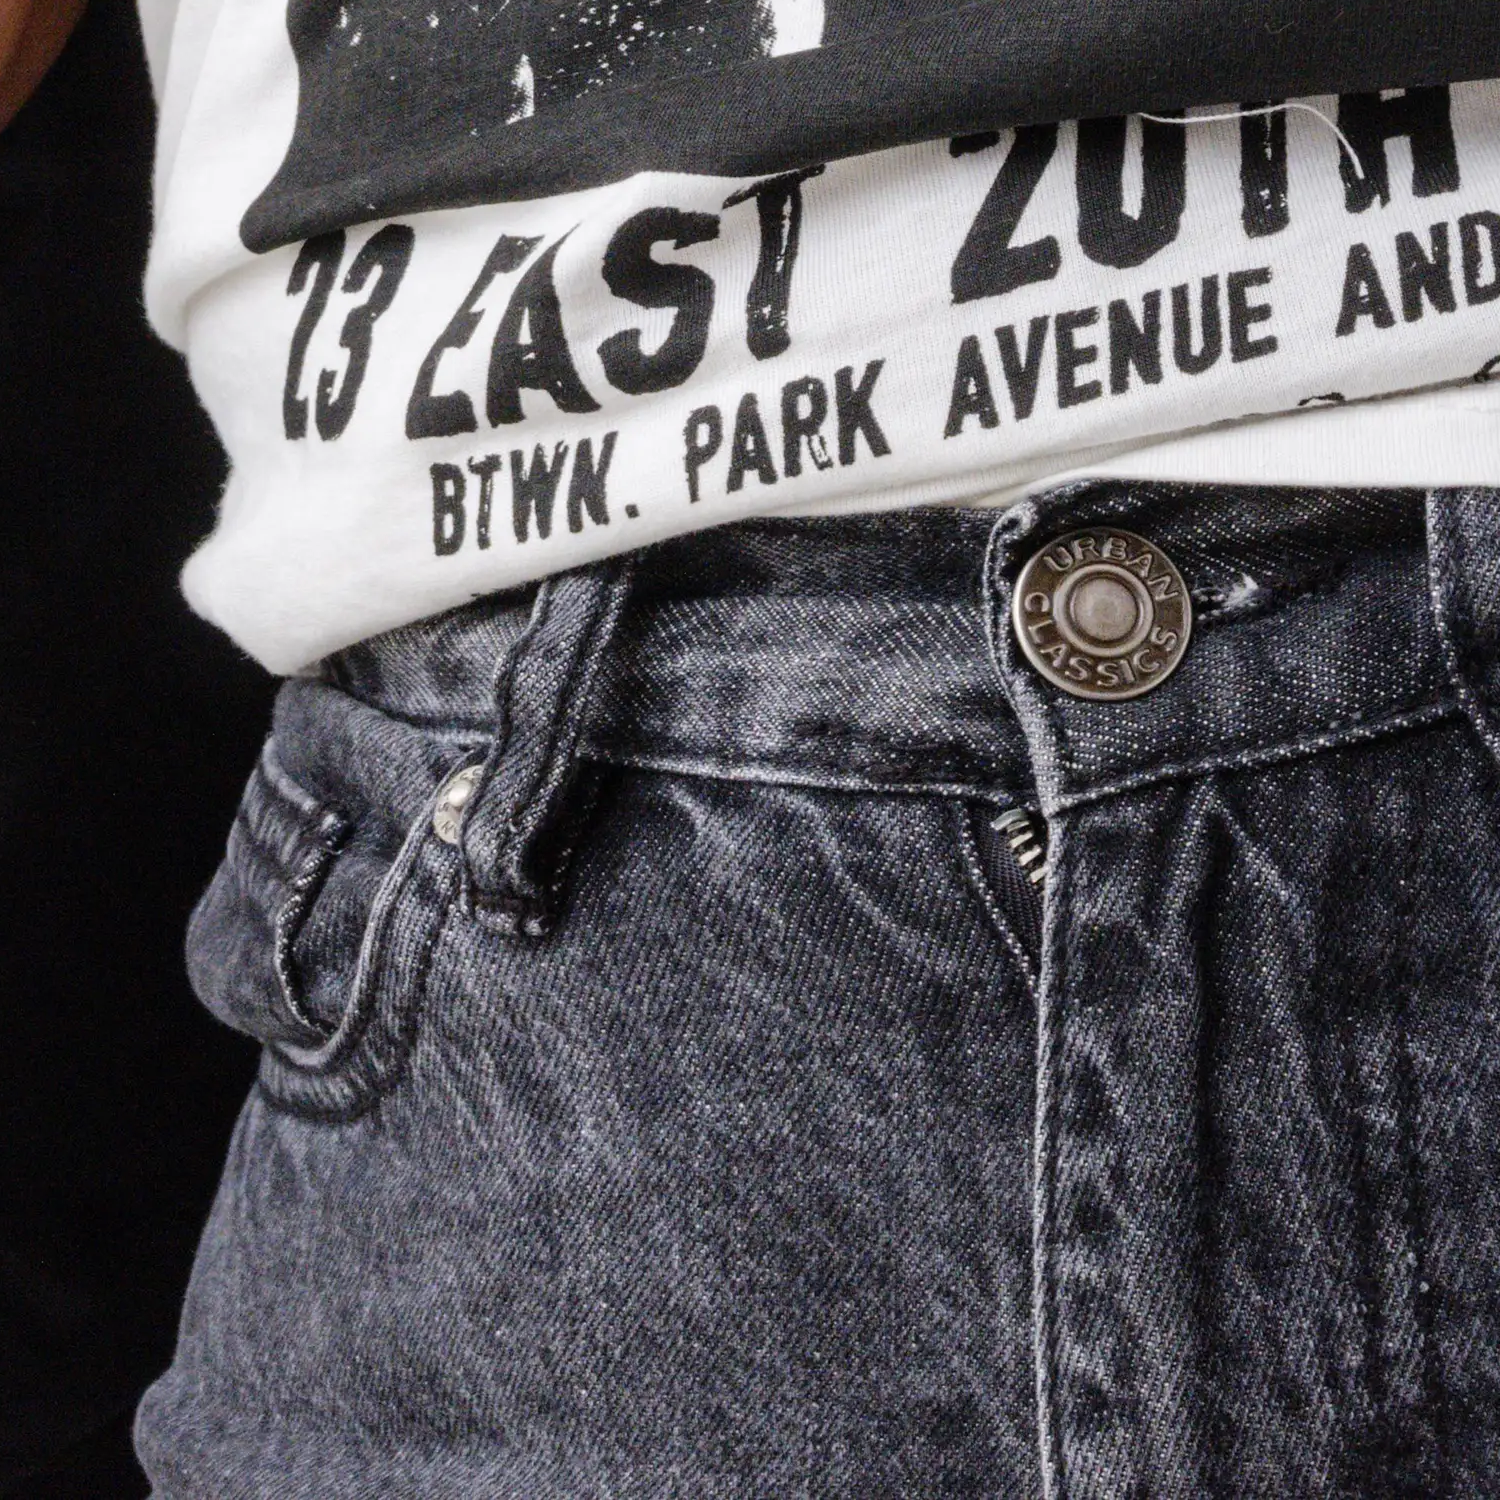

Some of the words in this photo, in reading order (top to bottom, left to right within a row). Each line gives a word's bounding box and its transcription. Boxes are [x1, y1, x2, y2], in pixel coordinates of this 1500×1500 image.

[283, 223, 415, 441] 23
[404, 163, 826, 440] EAST
[948, 81, 1462, 306] 20TH
[430, 430, 640, 558] BTWN.
[682, 358, 892, 503] PARK
[942, 265, 1280, 439] AVENUE
[1023, 591, 1179, 687] CLASSICS
[1043, 536, 1180, 602] URBAN
